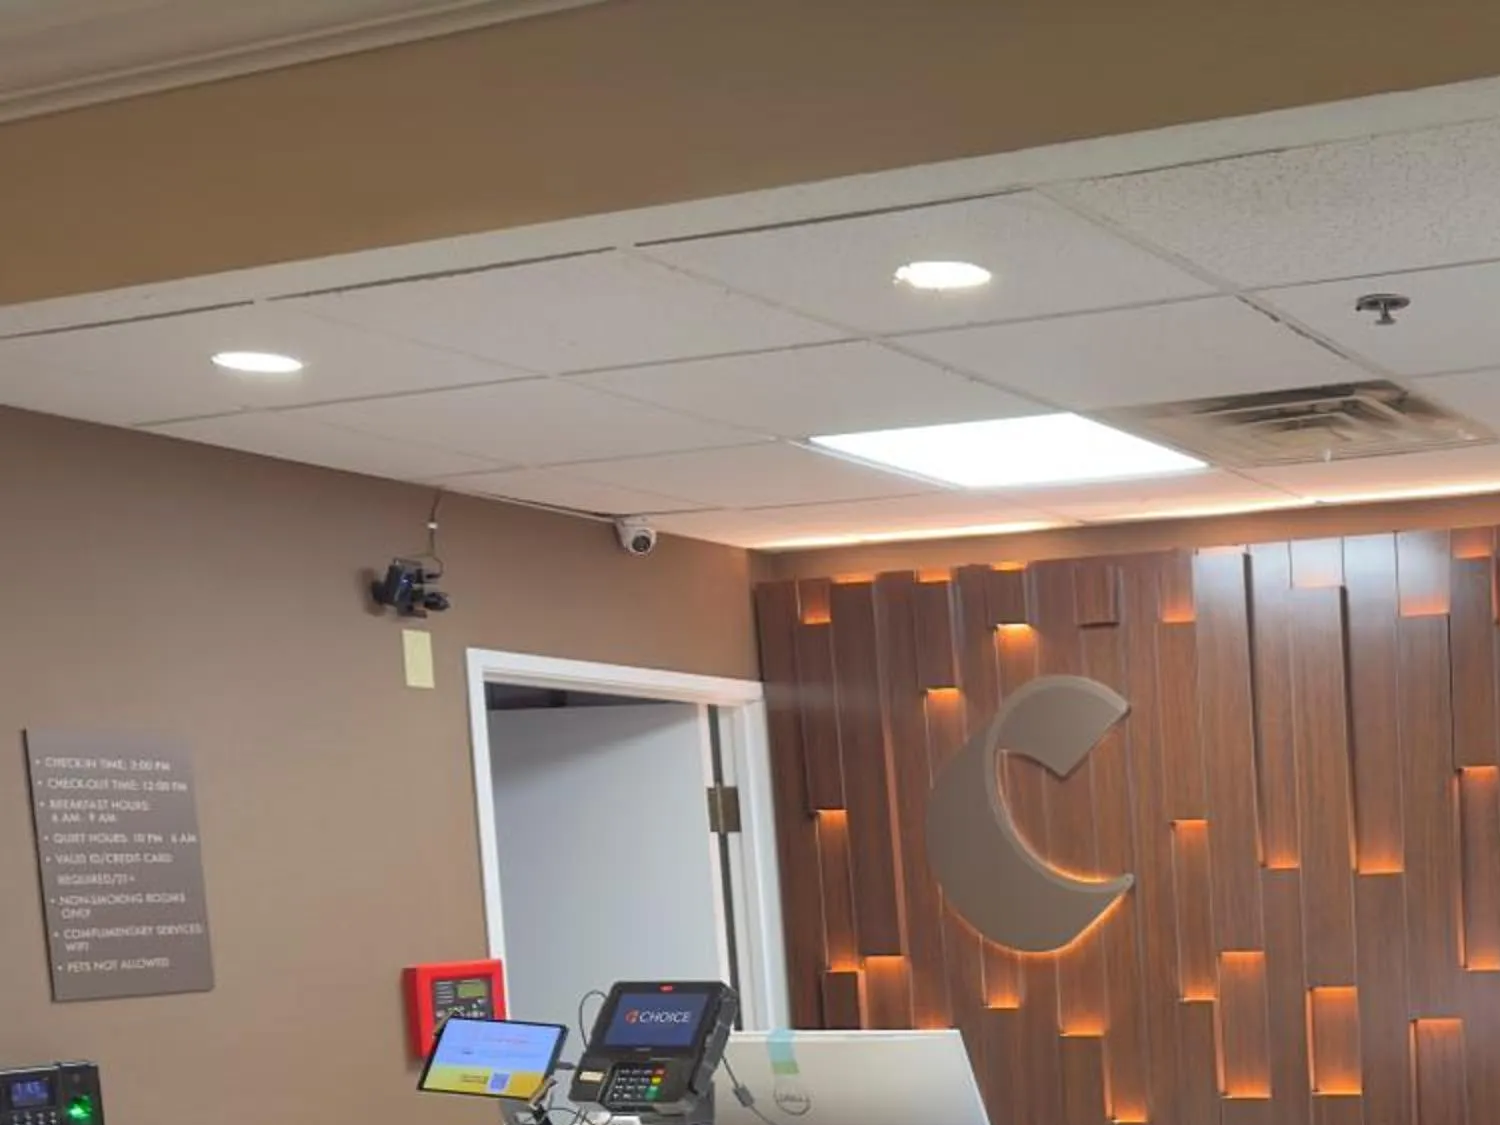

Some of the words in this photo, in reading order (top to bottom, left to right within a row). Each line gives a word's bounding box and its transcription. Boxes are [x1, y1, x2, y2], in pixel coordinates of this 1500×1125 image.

[155, 760, 171, 771] PM
[172, 781, 188, 793] PM
[50, 798, 109, 811] BREAKFAST
[61, 812, 81, 823] AM
[98, 813, 118, 823] AM
[53, 832, 85, 845] QUIET
[147, 833, 163, 845] PM
[180, 831, 198, 844] AM
[55, 853, 86, 865] VALID
[145, 891, 186, 904] ROOMS
[61, 907, 91, 920] ONLY
[67, 960, 92, 974] PETS
[93, 959, 118, 972] NOT
[120, 956, 170, 970] ALLOWED
[639, 1009, 692, 1023] CHOICE
